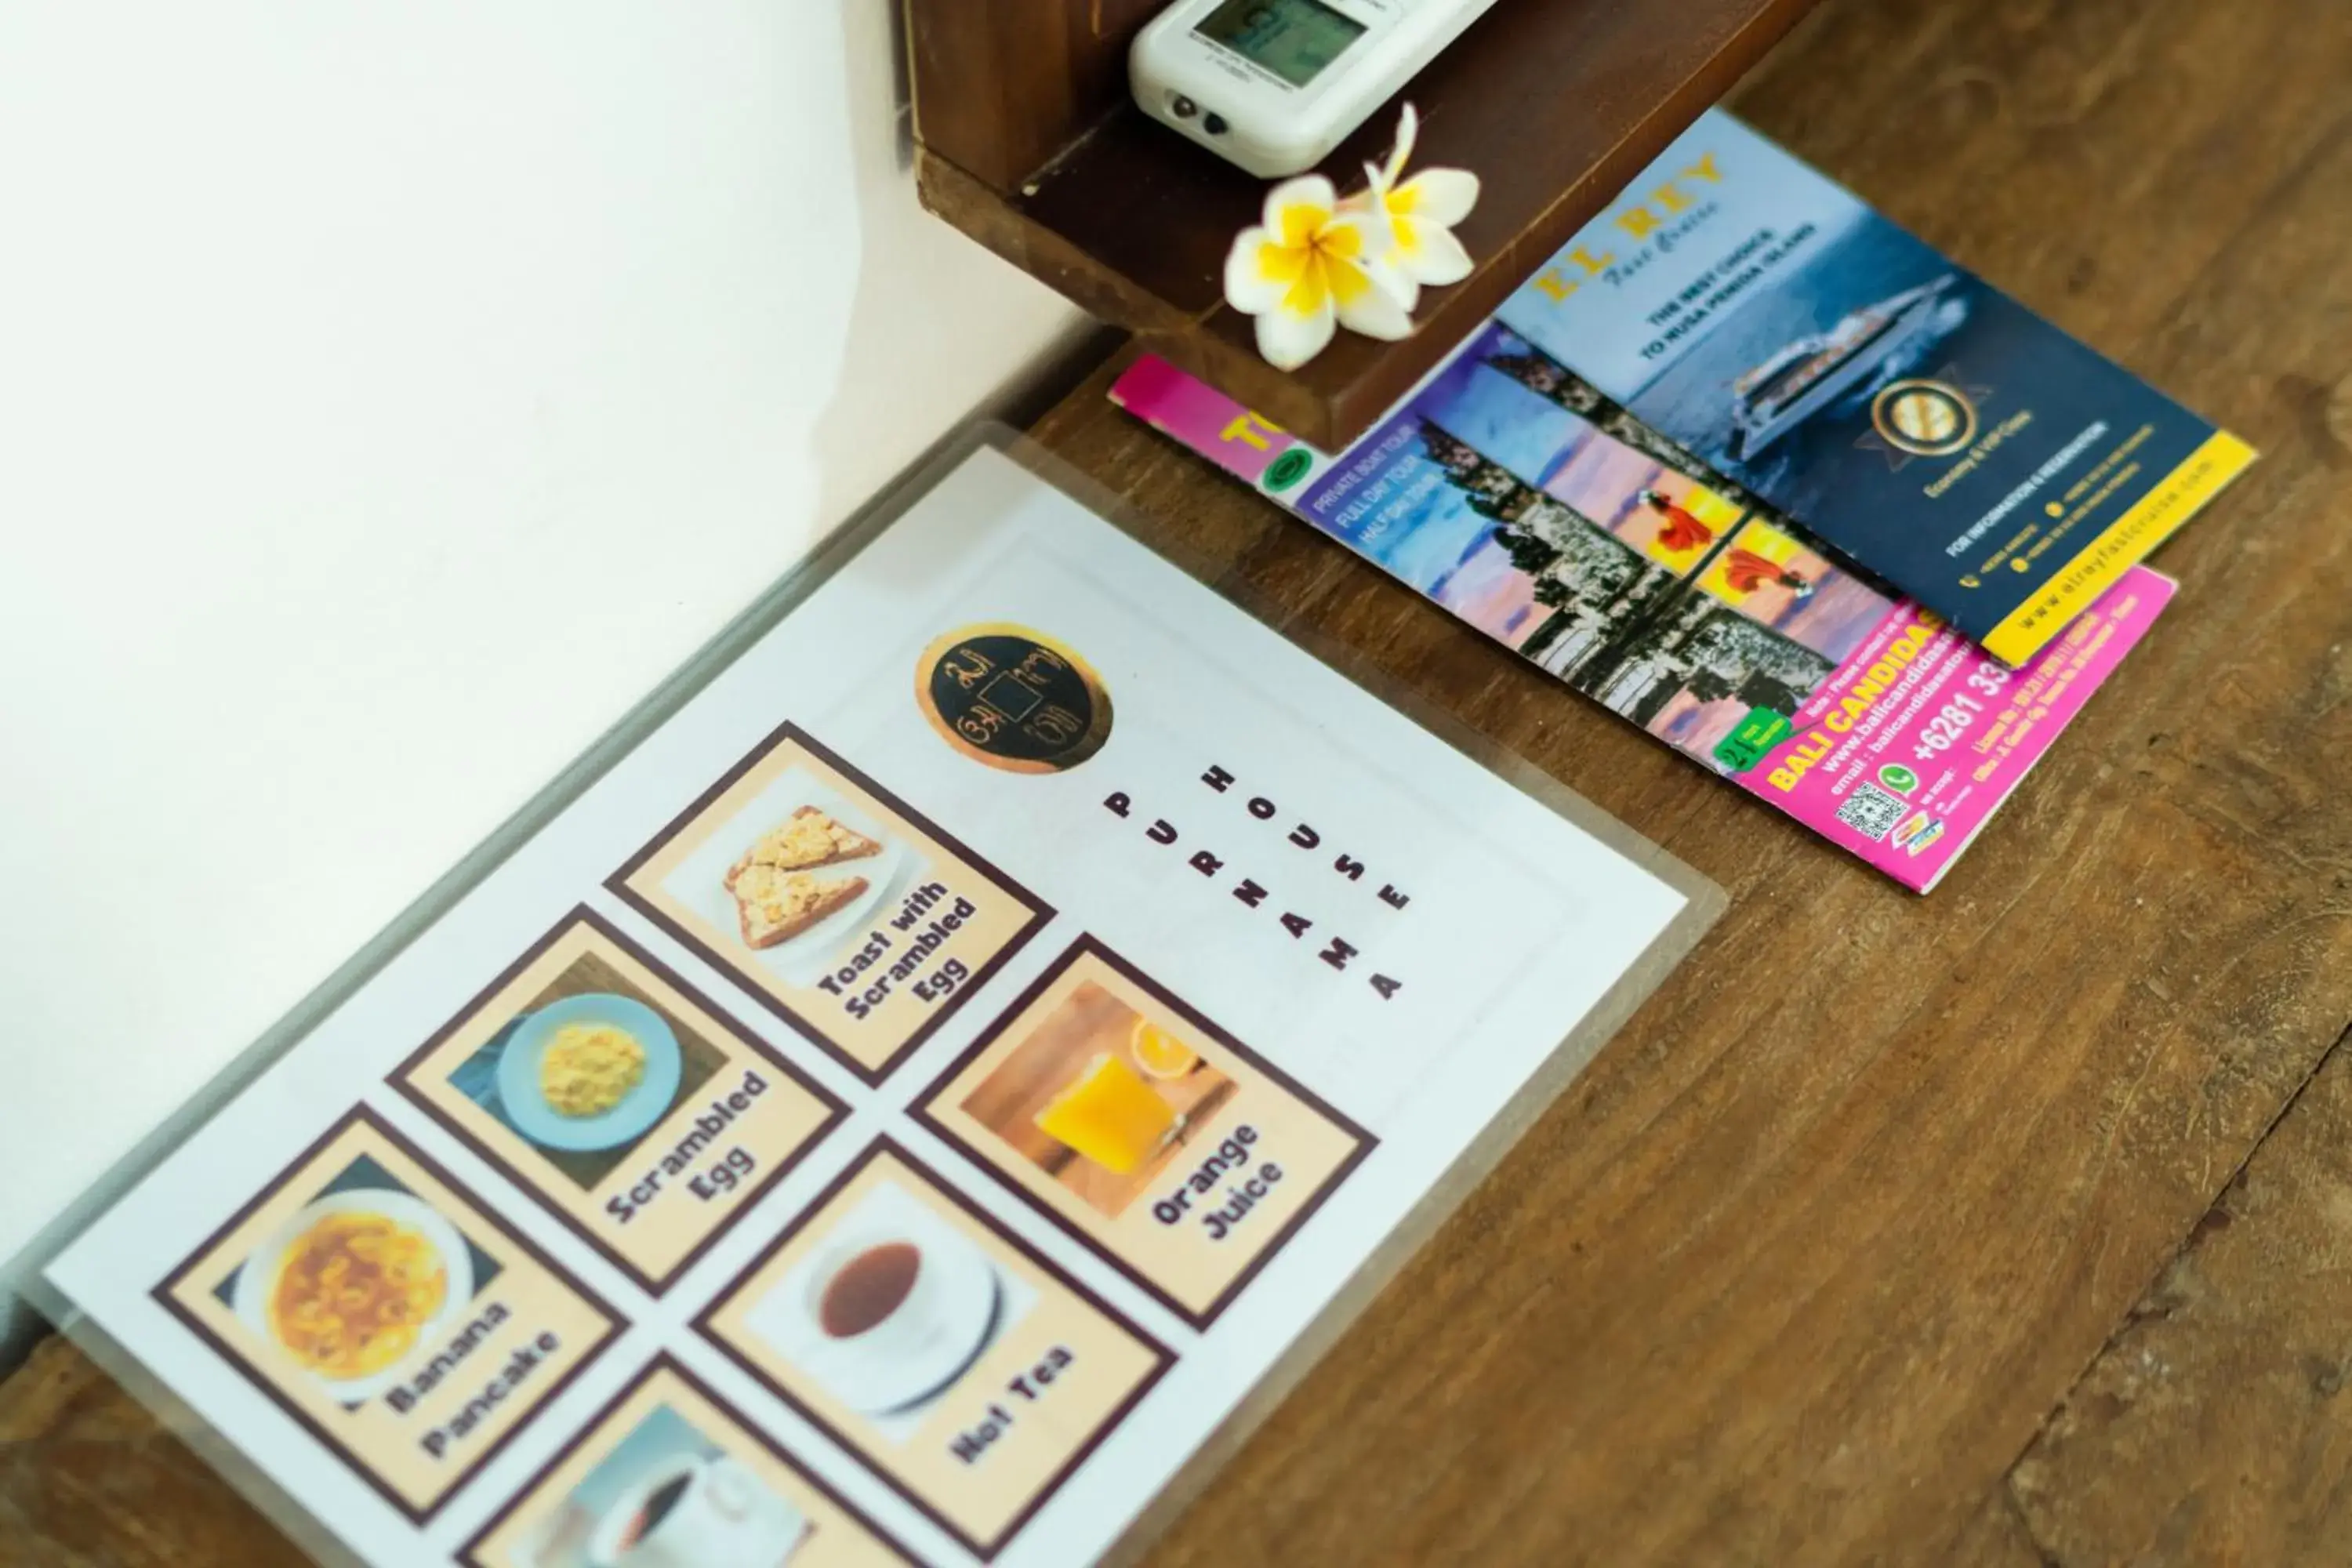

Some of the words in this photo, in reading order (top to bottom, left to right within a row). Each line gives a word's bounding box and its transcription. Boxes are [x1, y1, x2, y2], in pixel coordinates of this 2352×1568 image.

[1639, 339, 1665, 359] TO
[1662, 309, 1709, 343] NUSA
[1312, 470, 1358, 514] PRIVATE
[1334, 499, 1367, 529] FULL
[1361, 477, 1390, 505] DAY
[1385, 455, 1422, 481] TOUR
[1945, 535, 1973, 558] FOR
[1767, 731, 1835, 793] BALI
[1912, 692, 1984, 760] +6281
[1831, 757, 1867, 796] email
[1200, 764, 1410, 910] HOUSE
[1103, 791, 1403, 1000] PURNAMA
[817, 931, 892, 996] Toast
[890, 881, 949, 931] with
[844, 896, 977, 1021] Scrambled
[911, 956, 969, 1003] Egg
[605, 1069, 769, 1224] Scrambled
[687, 1146, 757, 1202] Egg
[1152, 1123, 1259, 1225] Orange
[1200, 1161, 1284, 1242] Juice
[385, 1302, 510, 1414] Banana
[420, 1331, 559, 1459] Pancake
[949, 1403, 1014, 1465] Hot
[1007, 1345, 1074, 1402] Tea
